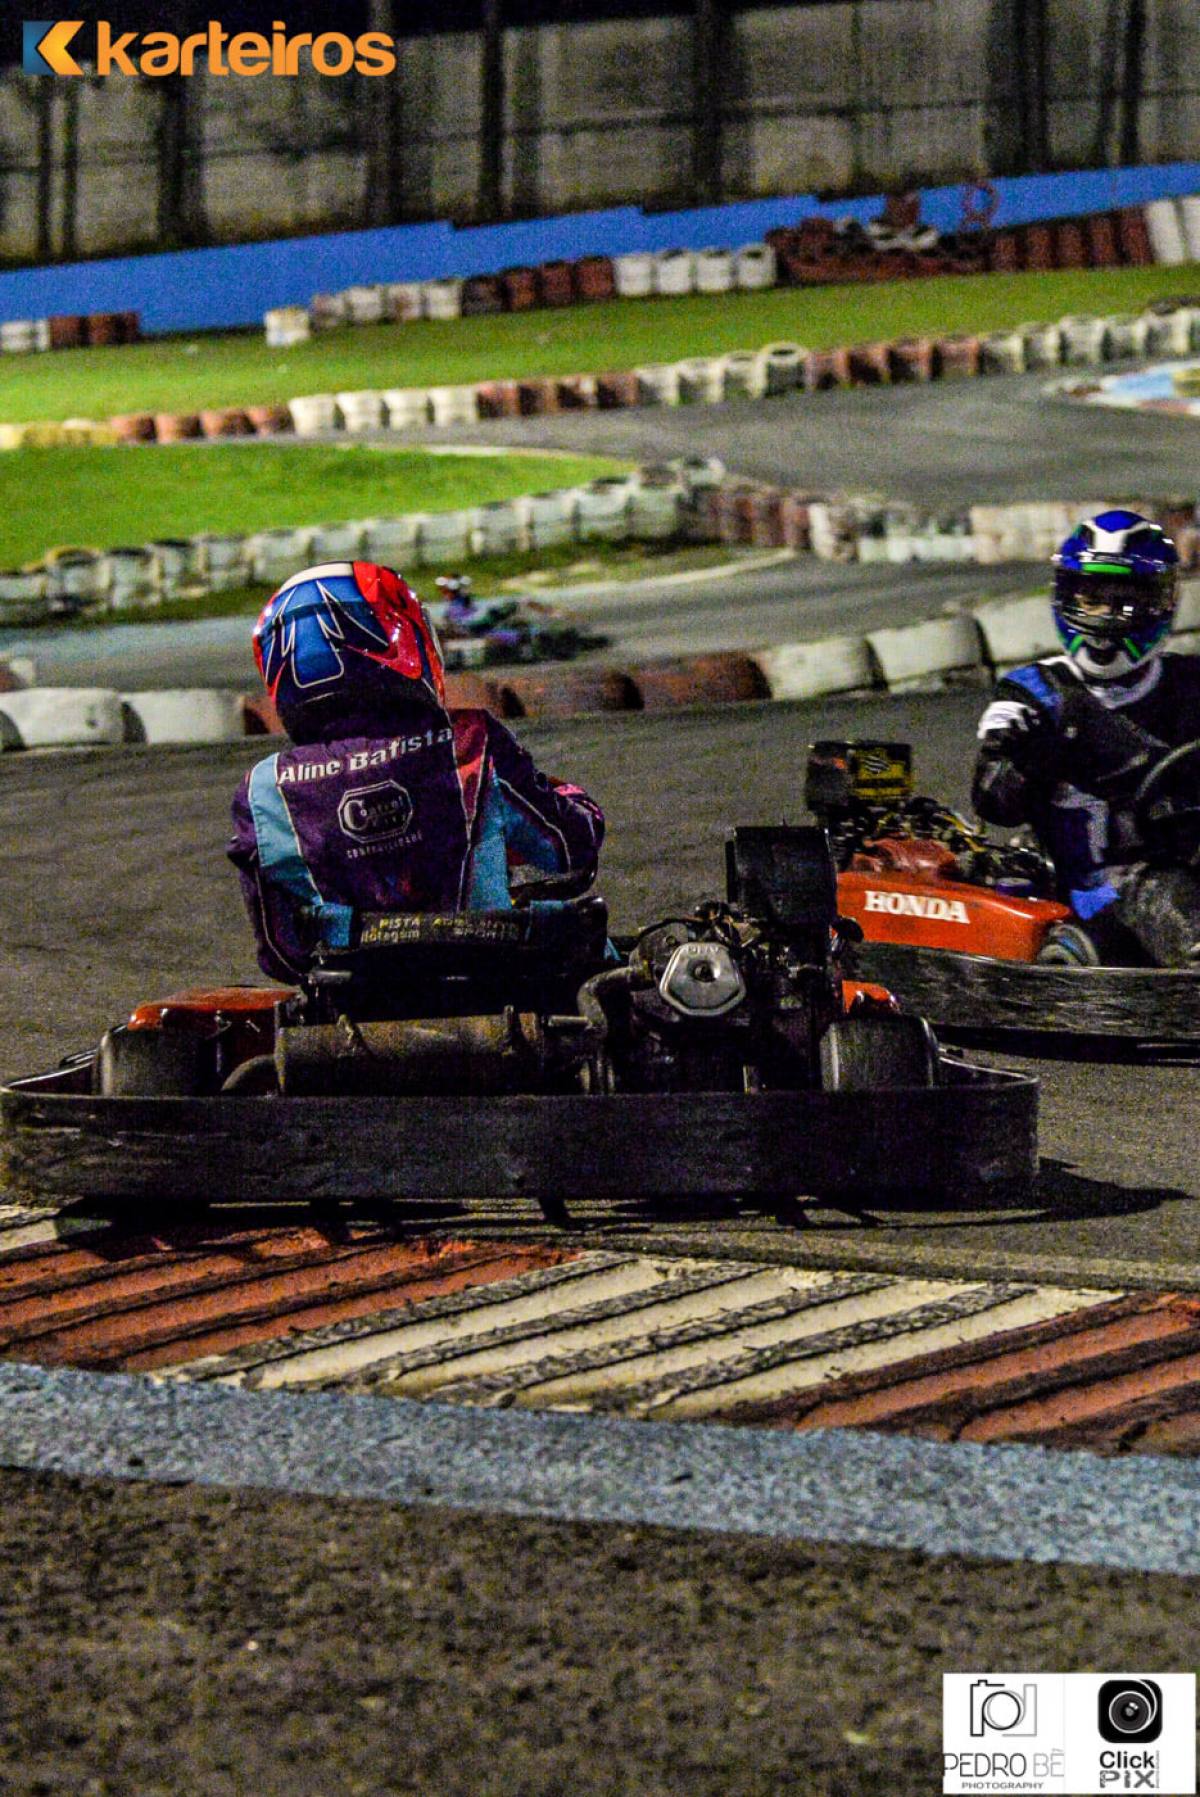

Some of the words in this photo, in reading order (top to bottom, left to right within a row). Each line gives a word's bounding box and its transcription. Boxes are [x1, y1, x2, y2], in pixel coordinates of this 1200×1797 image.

[278, 759, 341, 785] Aline
[349, 727, 454, 770] Batista
[864, 890, 971, 925] HONDA
